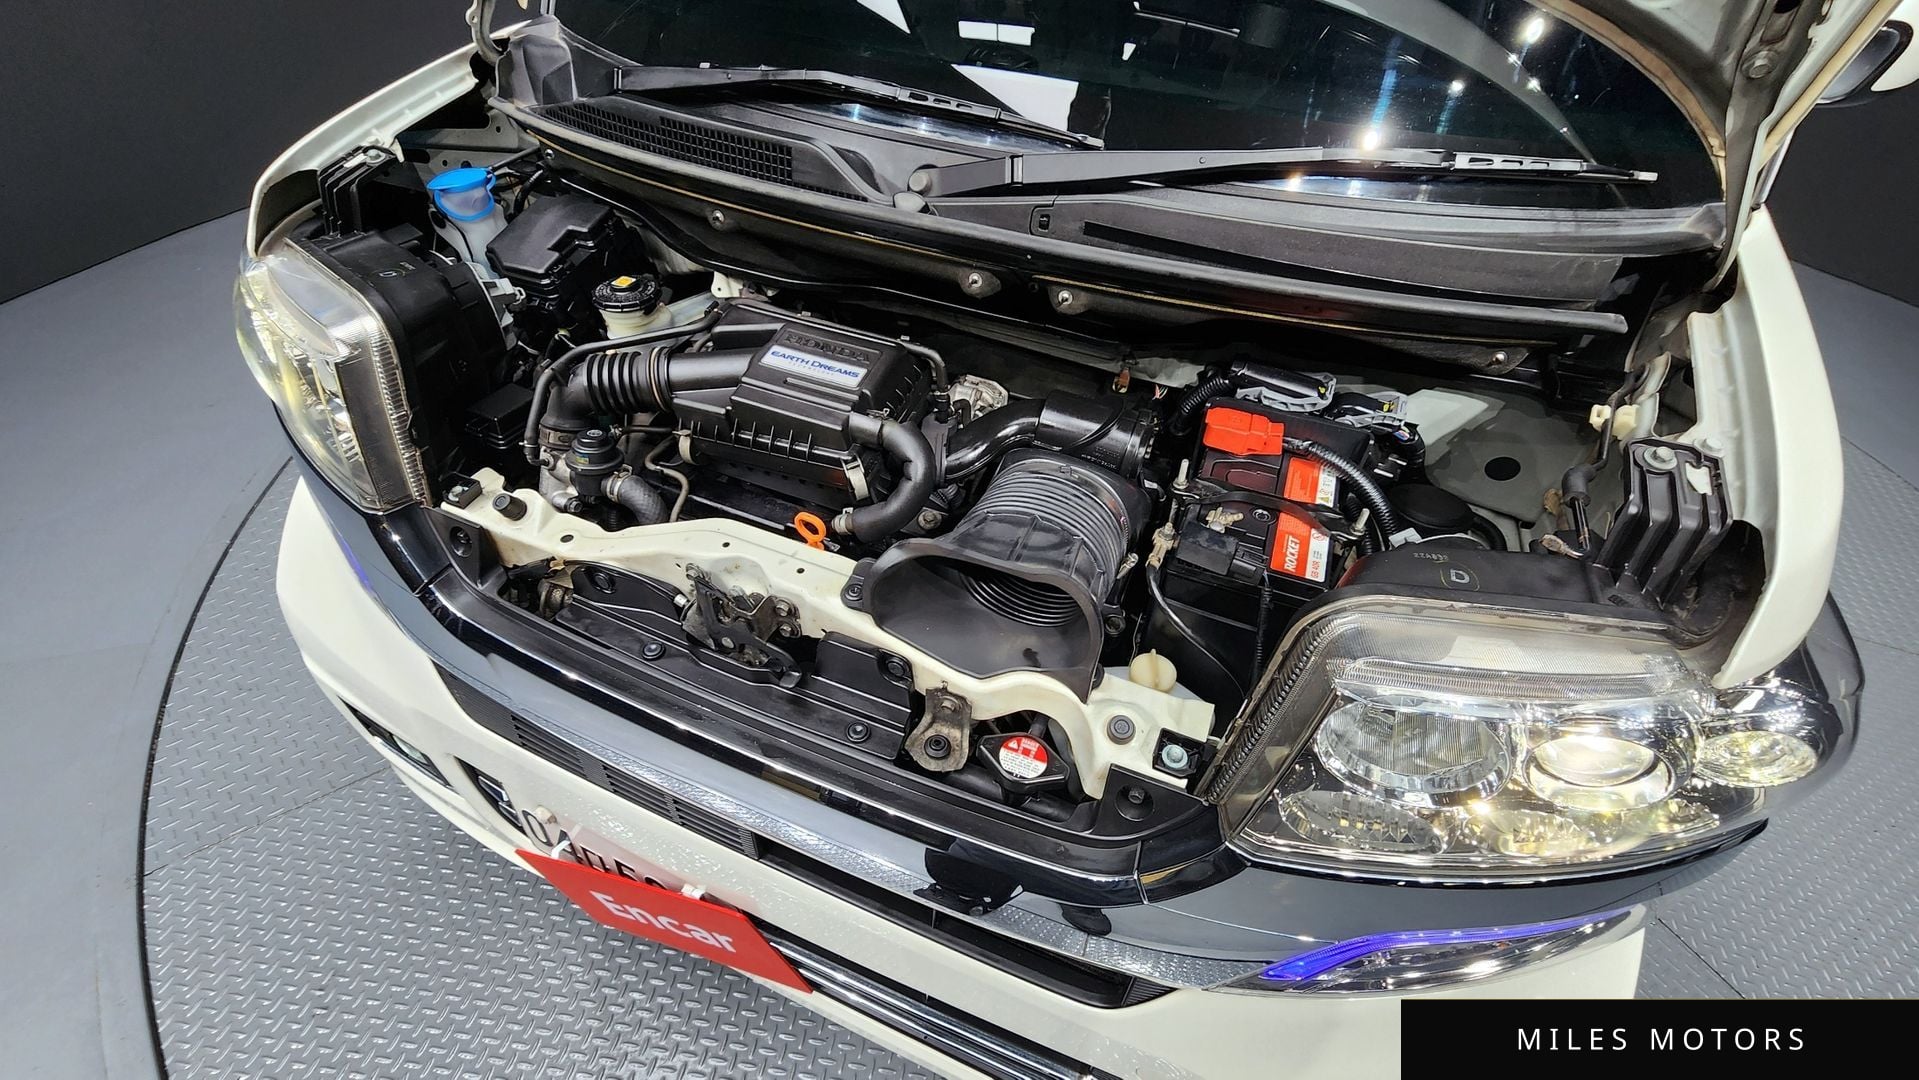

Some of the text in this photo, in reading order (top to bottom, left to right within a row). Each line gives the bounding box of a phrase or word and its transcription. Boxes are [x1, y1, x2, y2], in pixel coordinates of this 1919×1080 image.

[783, 333, 870, 362] HONDA
[771, 351, 809, 365] EARTH
[810, 360, 860, 378] DREAMS
[1284, 534, 1300, 573] ROCKET
[1449, 568, 1470, 584] D
[589, 890, 737, 953] Encar
